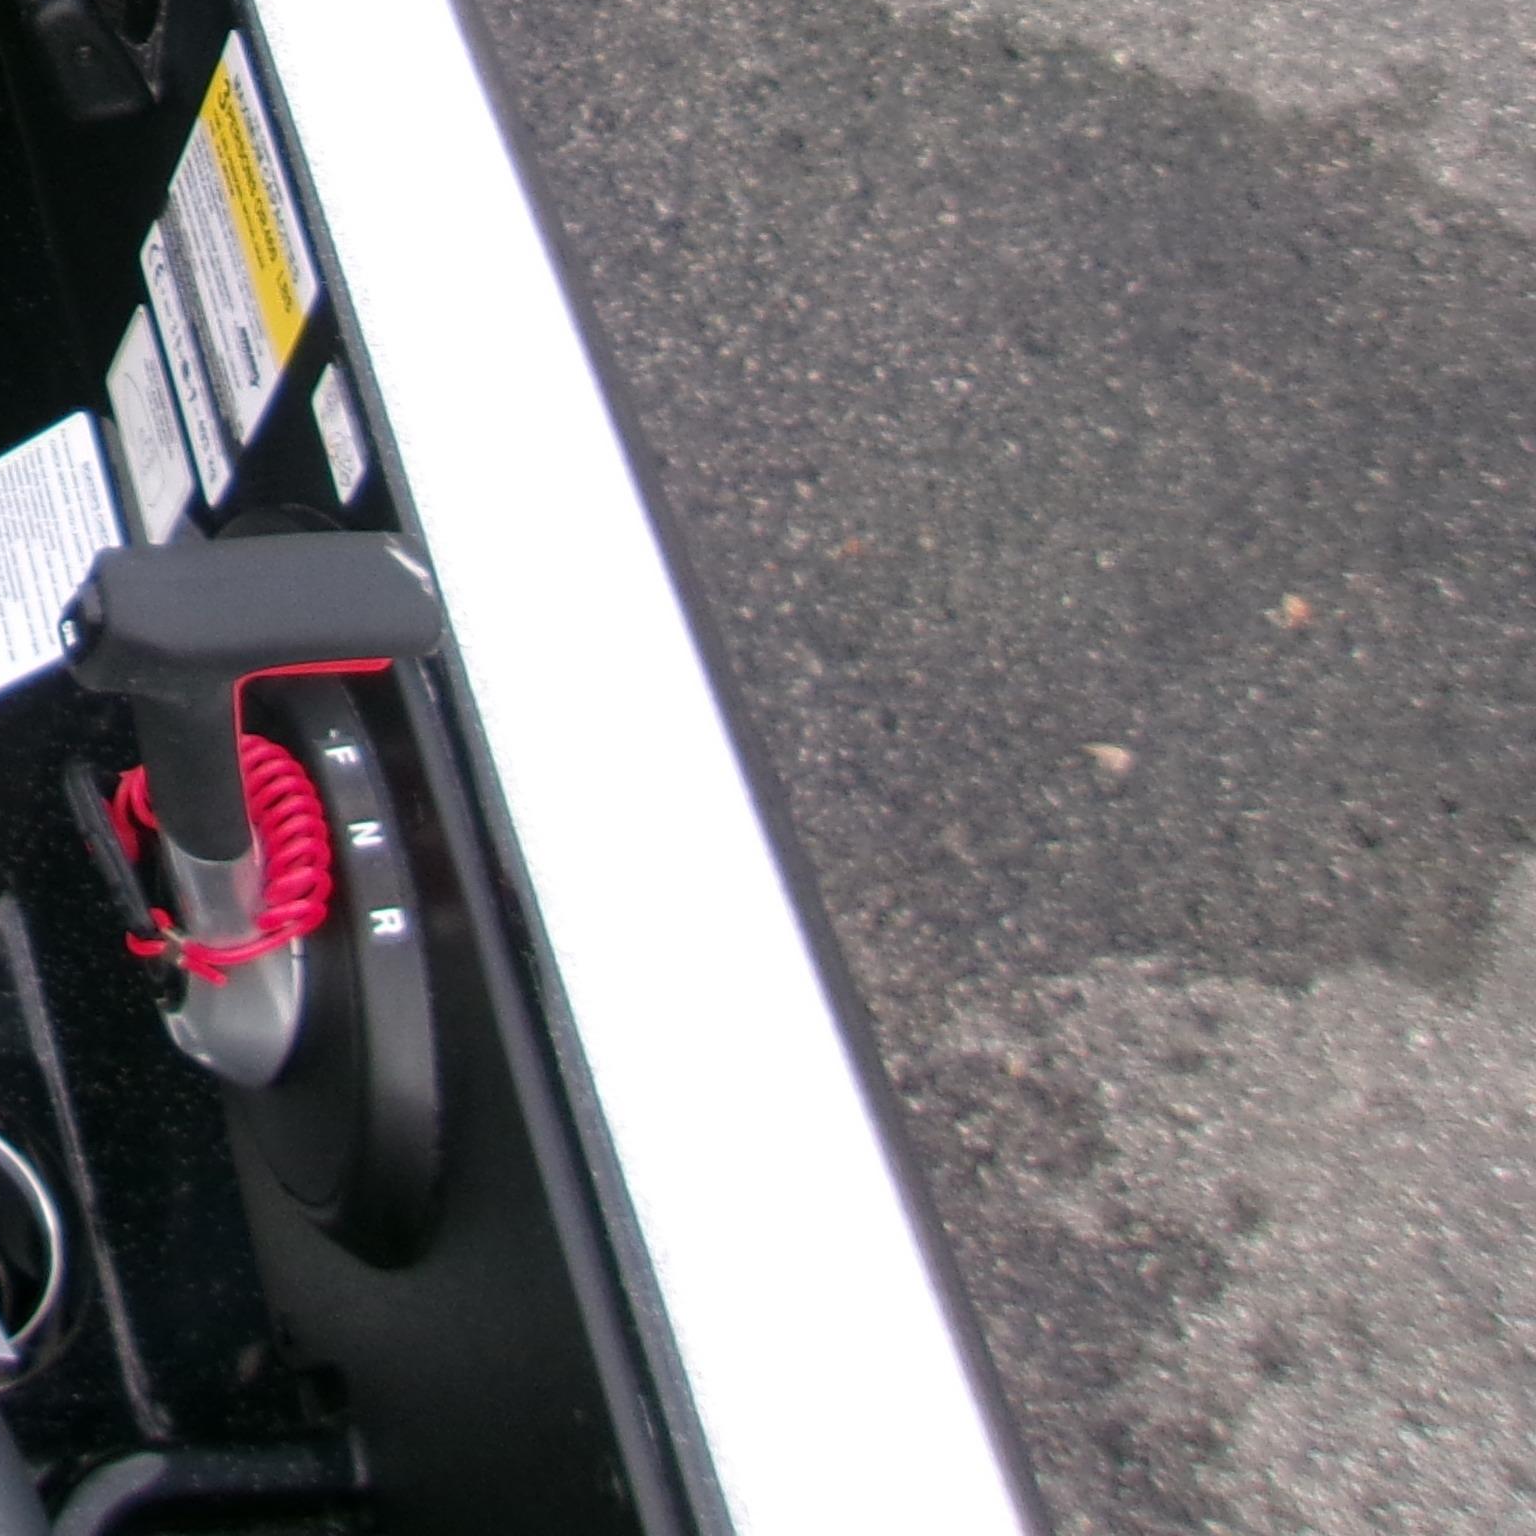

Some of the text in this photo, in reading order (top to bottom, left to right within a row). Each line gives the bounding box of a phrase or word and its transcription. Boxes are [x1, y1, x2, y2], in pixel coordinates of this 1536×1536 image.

[324, 745, 359, 764] F
[348, 821, 386, 847] N
[369, 907, 406, 934] R
